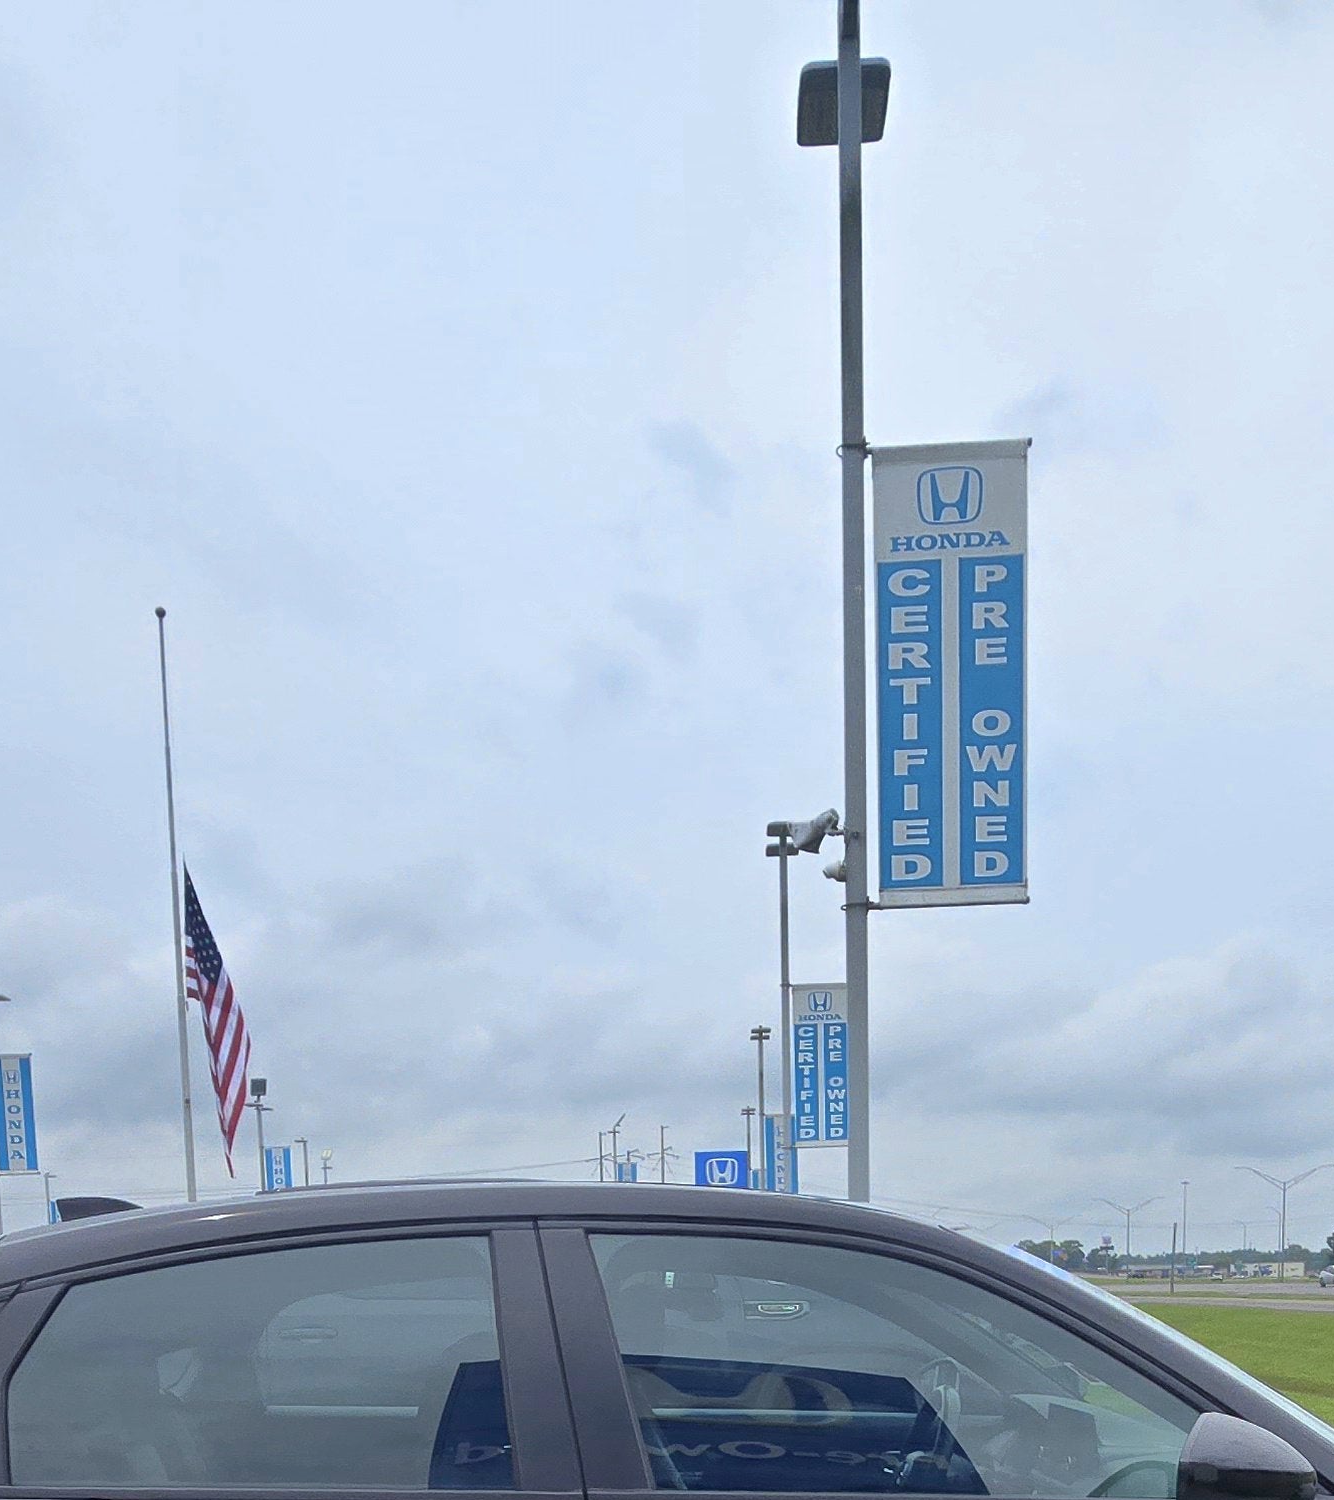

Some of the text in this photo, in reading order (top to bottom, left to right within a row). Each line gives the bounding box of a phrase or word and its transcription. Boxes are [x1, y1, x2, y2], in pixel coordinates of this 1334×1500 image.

[890, 530, 1010, 553] HONDA
[887, 568, 932, 881] CERTIFIED
[965, 564, 1017, 877] PRE OWNED
[798, 1013, 842, 1021] HONDA
[5, 1089, 25, 1160] HONDA
[797, 1026, 816, 1139] CERTIFIED
[826, 1025, 846, 1138] PRE OWNED
